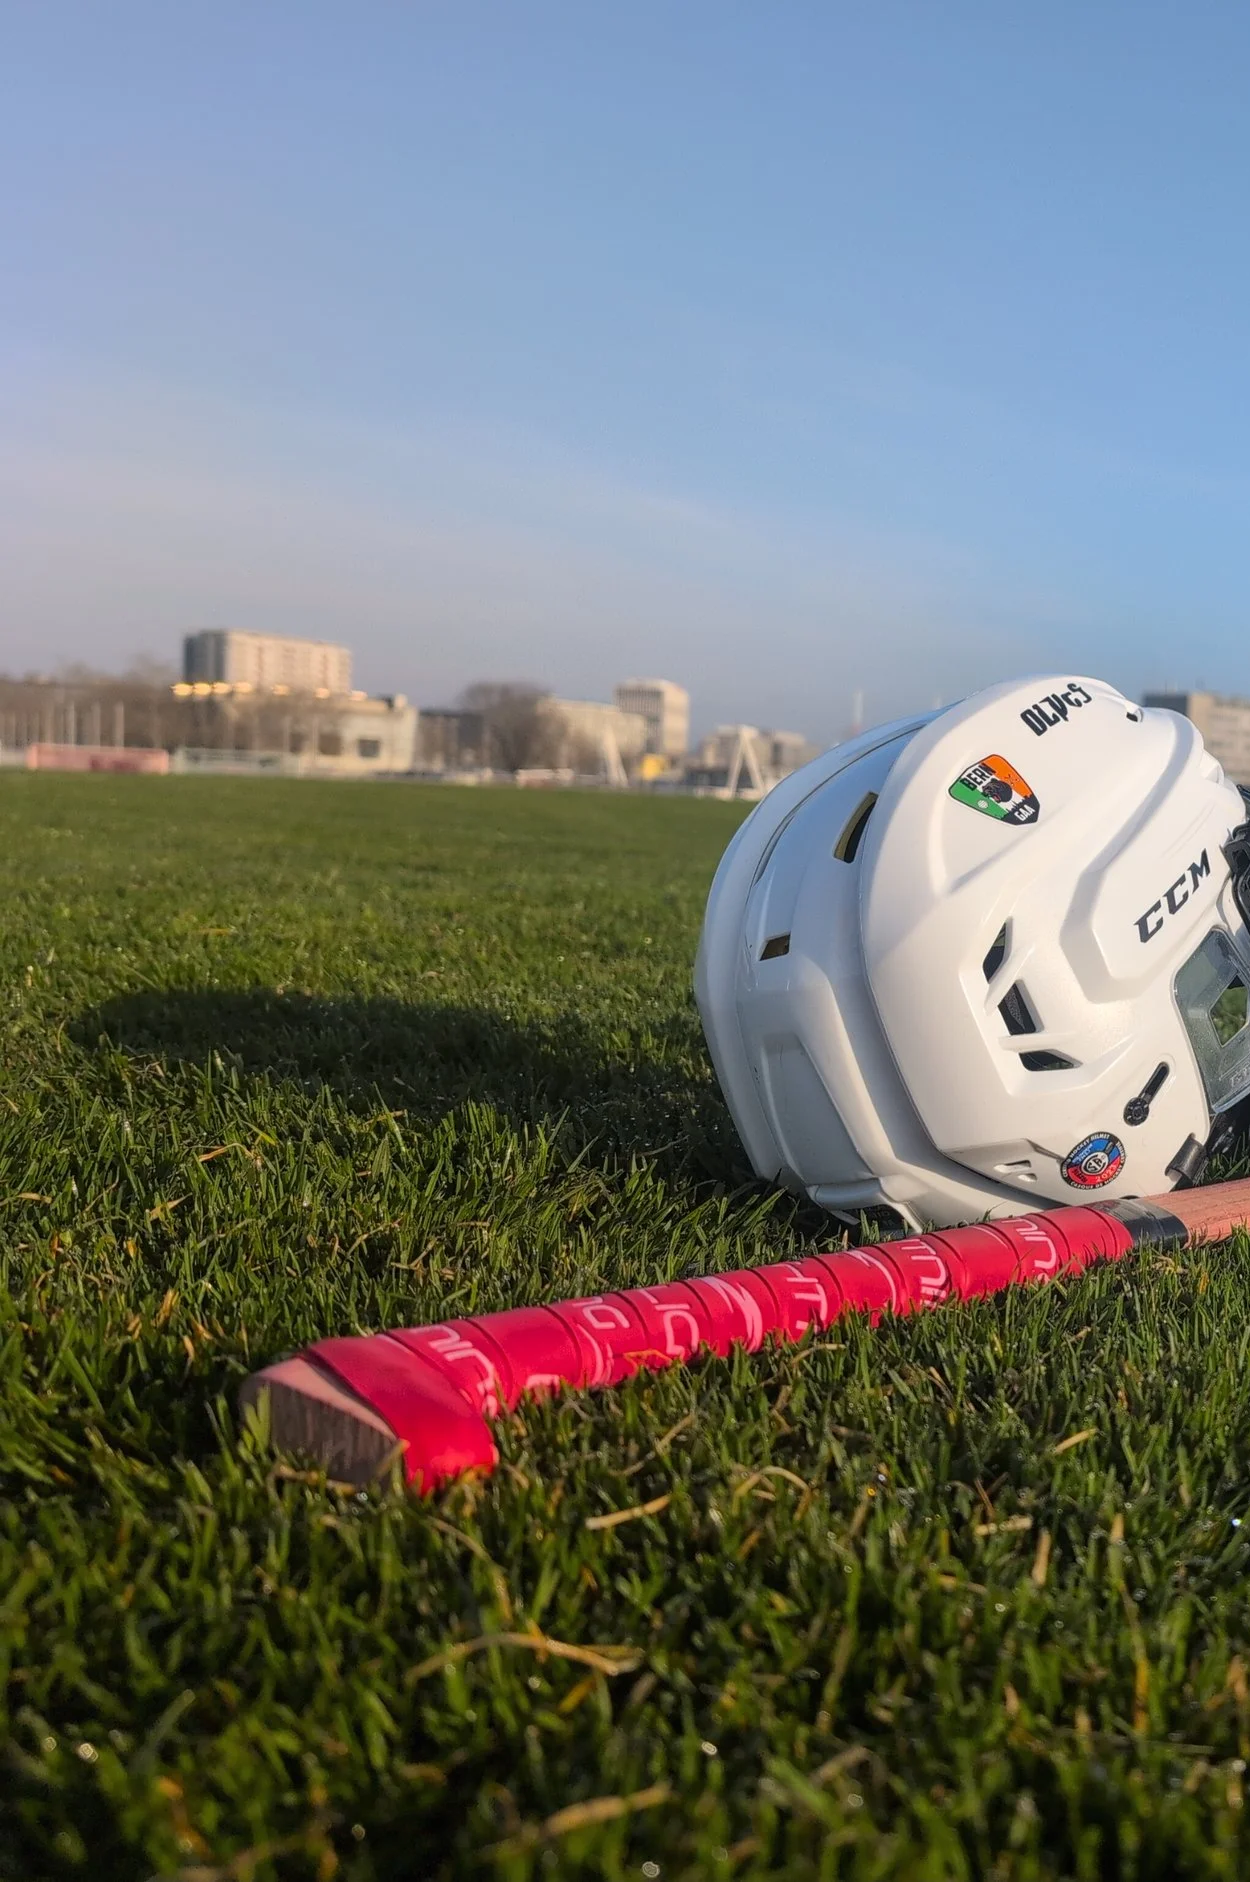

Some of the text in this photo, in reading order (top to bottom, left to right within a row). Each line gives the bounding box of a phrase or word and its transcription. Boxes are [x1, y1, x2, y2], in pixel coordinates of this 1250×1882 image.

[960, 762, 997, 792] BERN
[1014, 804, 1036, 822] GAA
[1133, 848, 1211, 944] CCM
[1070, 1137, 1090, 1159] HOCKEY
